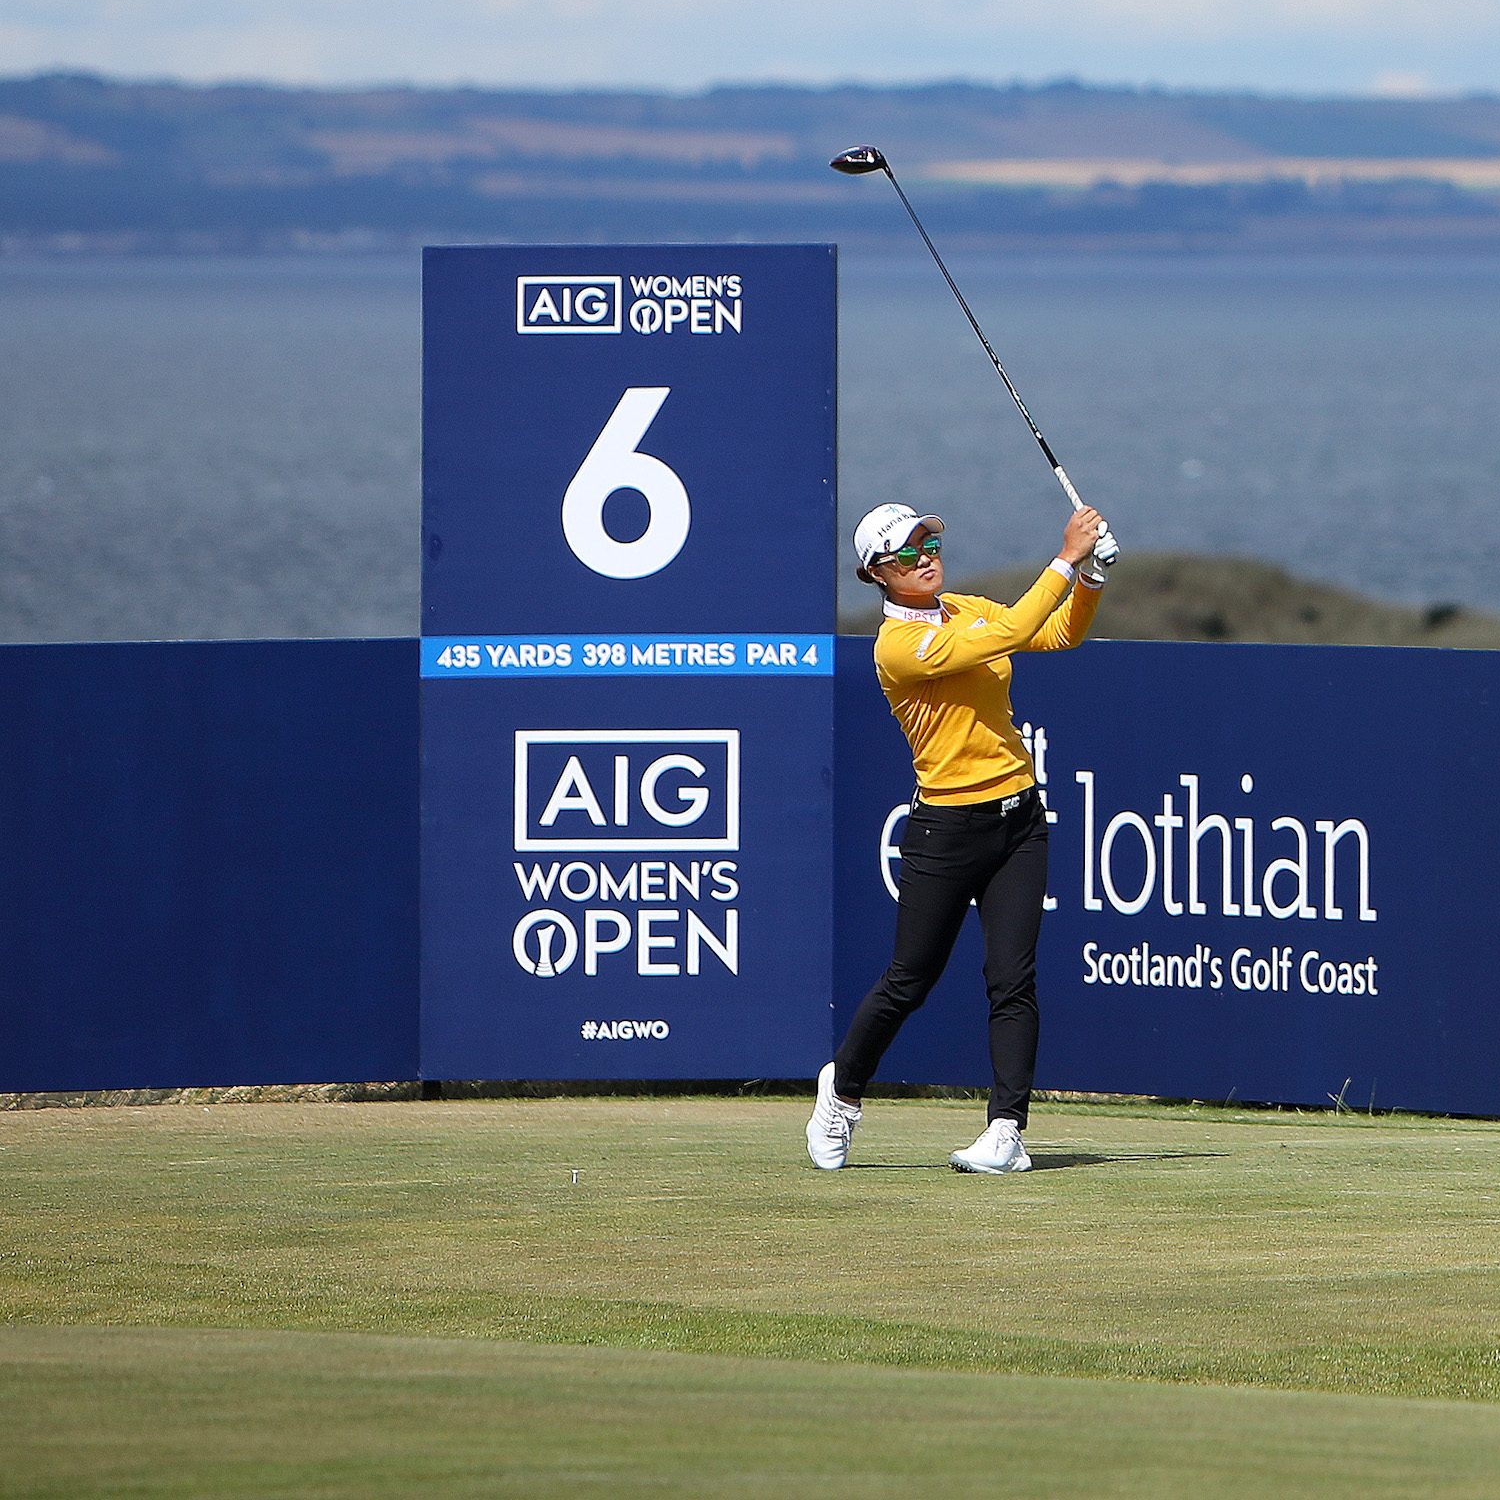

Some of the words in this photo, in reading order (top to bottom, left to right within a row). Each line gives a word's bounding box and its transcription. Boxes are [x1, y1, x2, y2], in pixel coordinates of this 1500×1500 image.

[528, 287, 609, 323] AIG
[629, 275, 742, 298] WOMEN'S
[629, 298, 742, 334] OPEN
[561, 386, 691, 579] 6
[903, 611, 929, 621] ISPS
[436, 644, 481, 668] 435
[485, 643, 573, 668] YARDS
[582, 643, 627, 667] 398
[631, 642, 736, 667] METRES
[746, 642, 798, 667] PAR
[801, 643, 819, 667] 4
[539, 754, 709, 826] AIG
[1075, 770, 1377, 921] lothian
[513, 861, 739, 902] WOMEN'S
[512, 908, 738, 977] OPEN
[1083, 941, 1223, 989] Scotland's
[1230, 946, 1293, 992] Golf
[1299, 950, 1378, 996] Coast
[580, 1020, 670, 1040] #AIGWO
